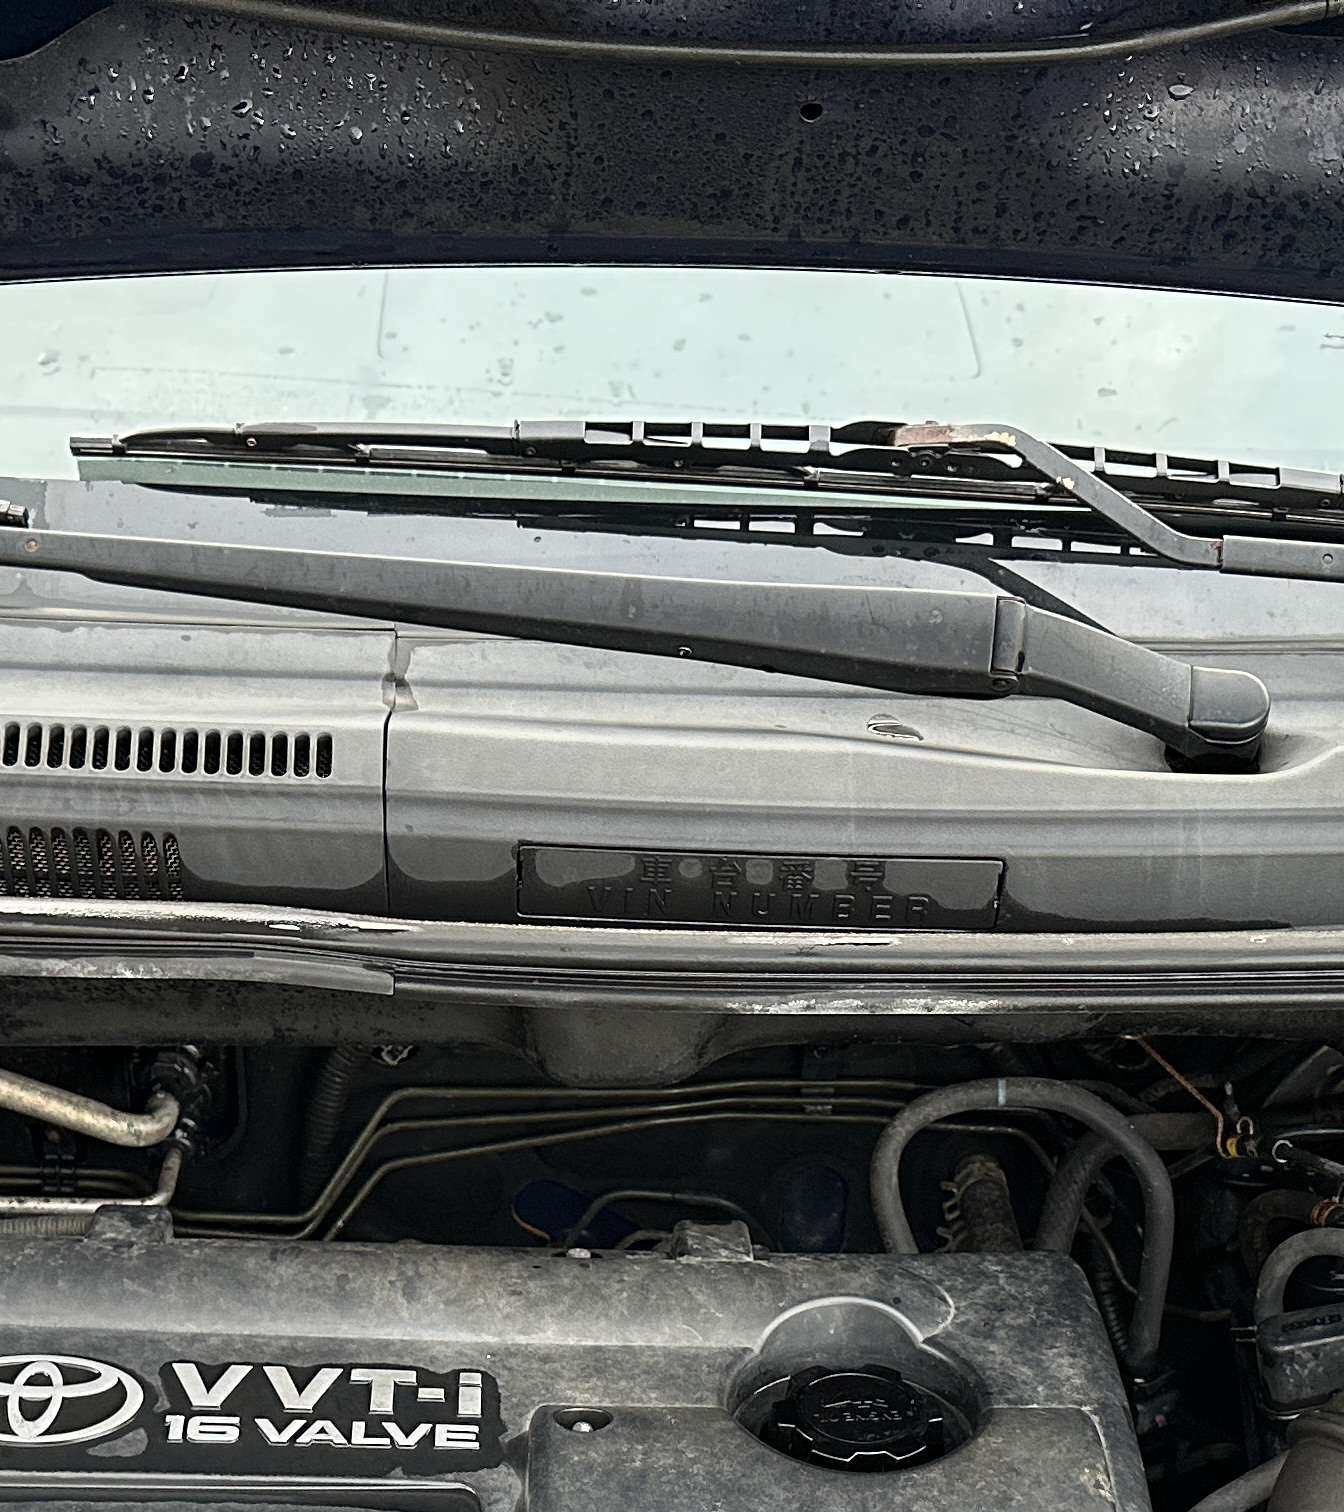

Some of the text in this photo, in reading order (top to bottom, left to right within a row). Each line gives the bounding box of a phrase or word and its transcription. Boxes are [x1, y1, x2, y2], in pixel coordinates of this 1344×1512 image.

[587, 886, 929, 920] VIN NUMBER
[171, 1361, 483, 1418] VVT-i
[164, 1414, 481, 1450] 16 VALVE
